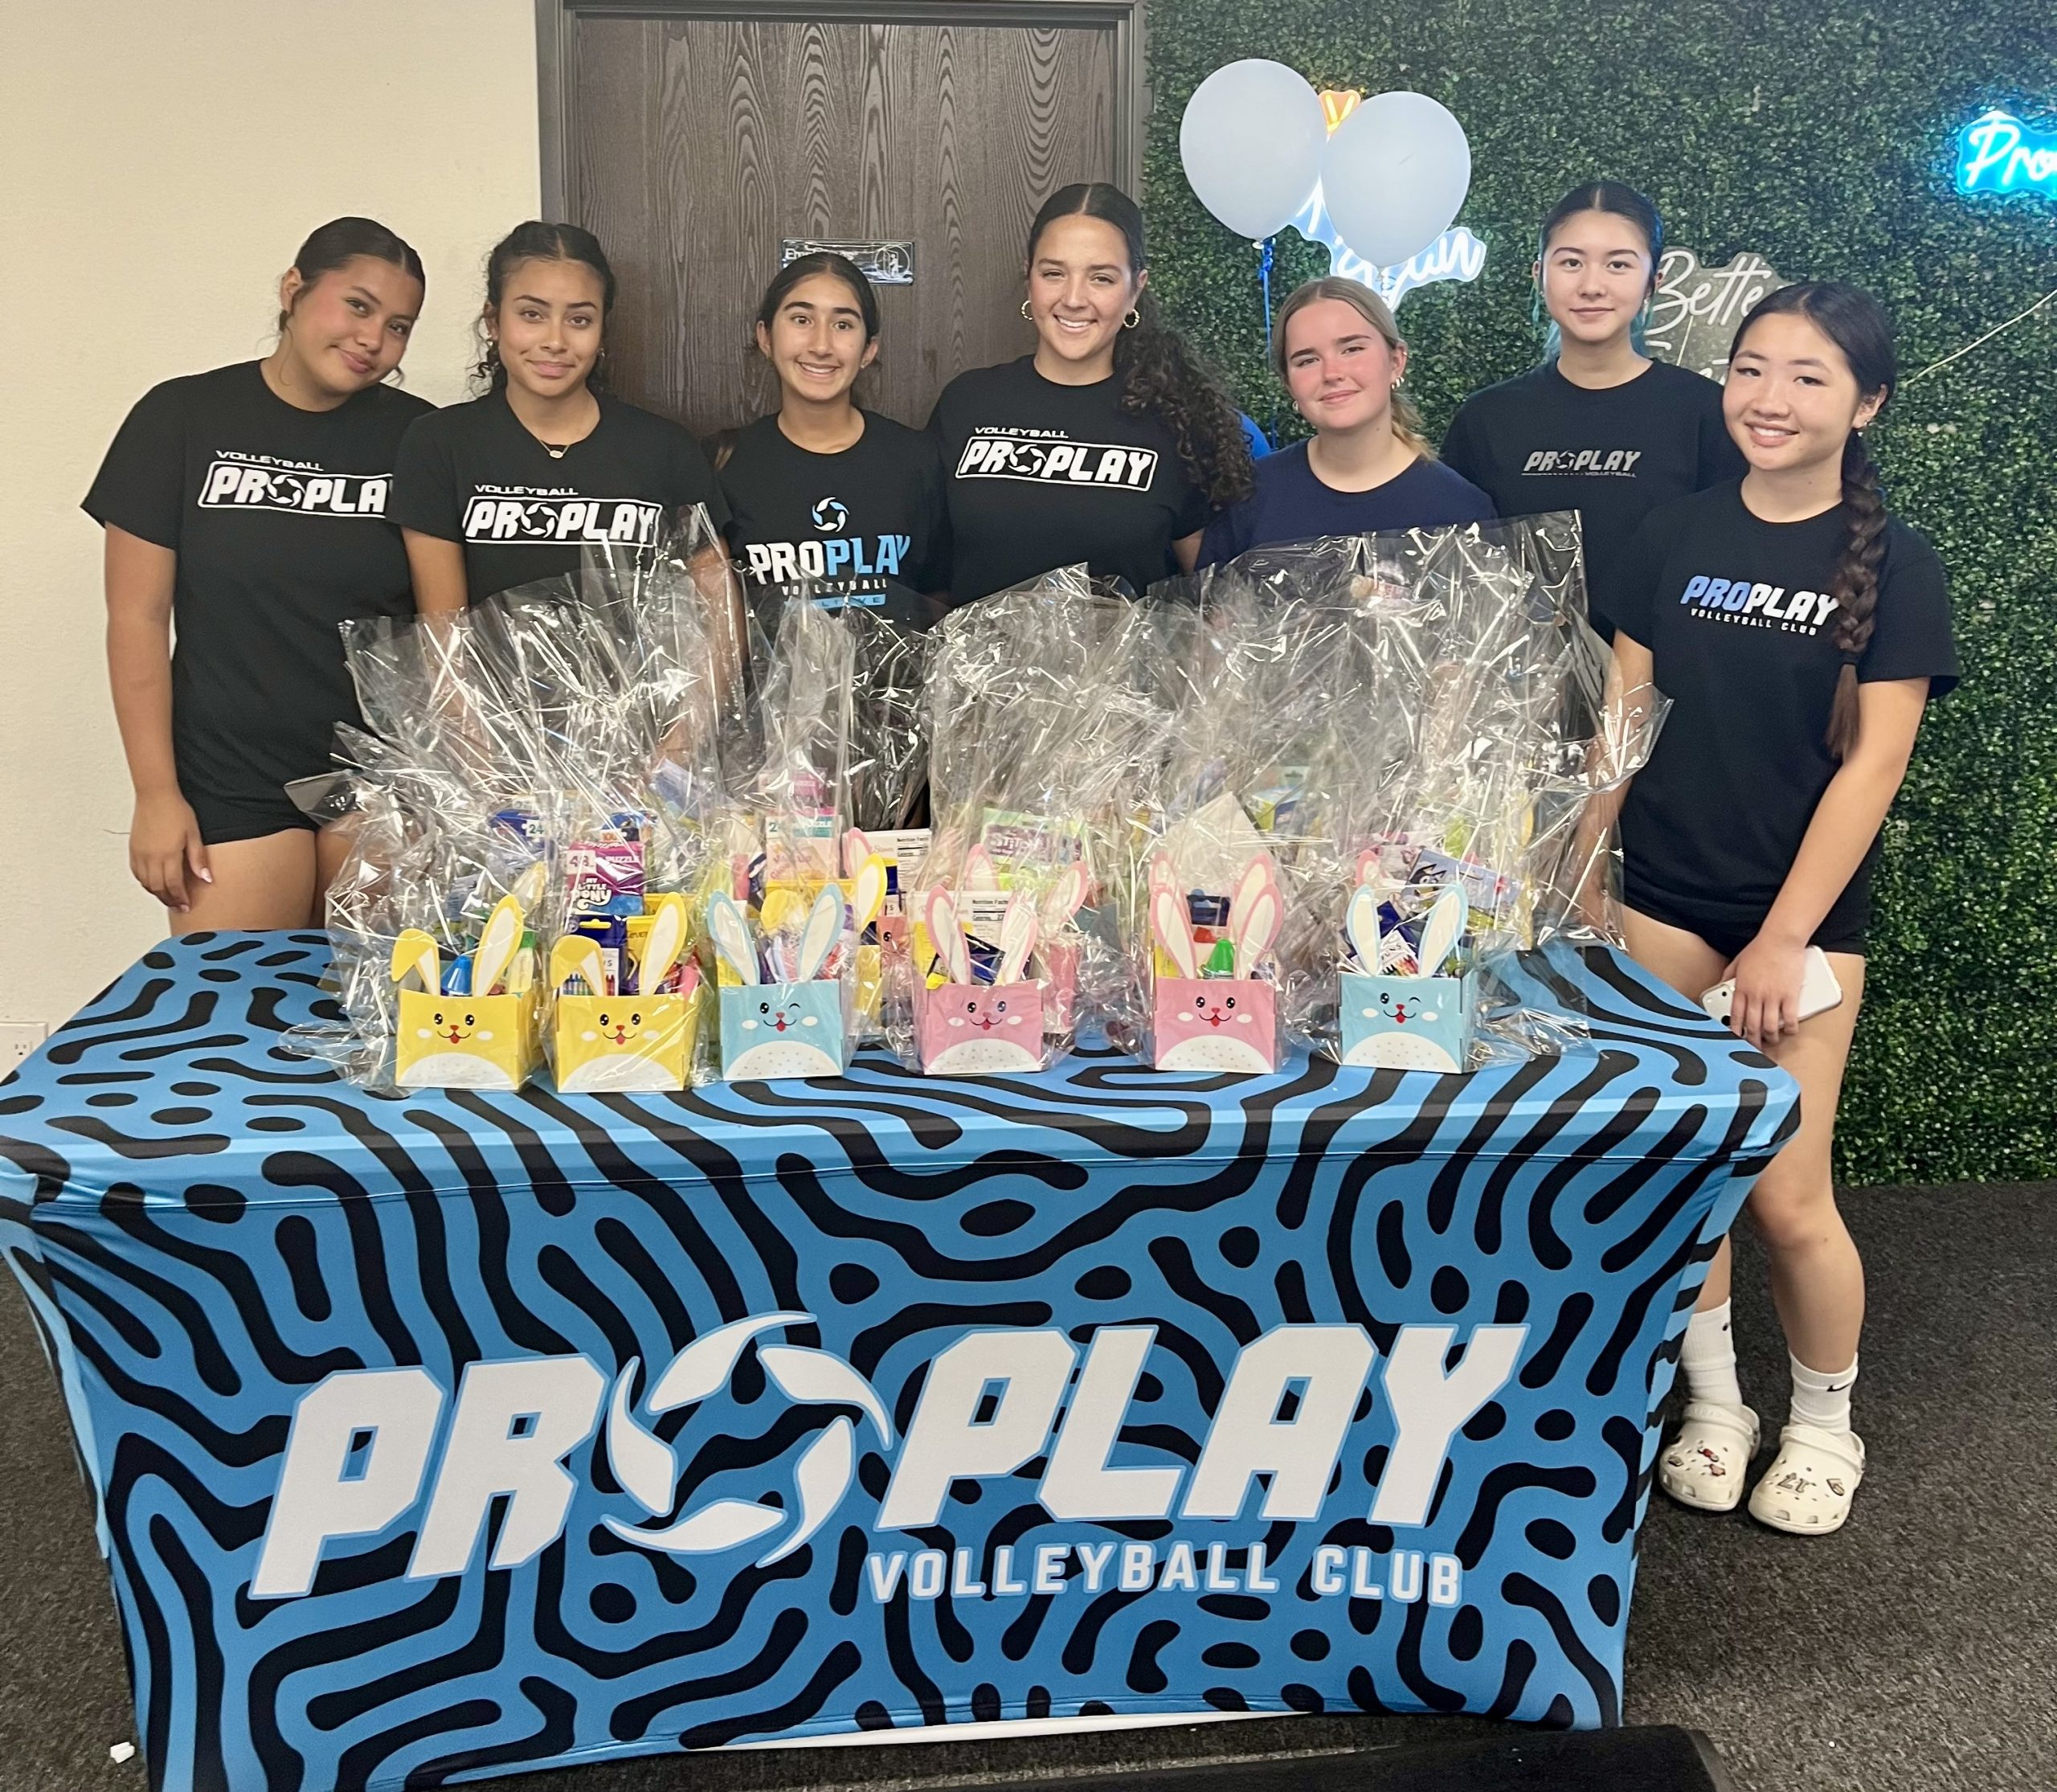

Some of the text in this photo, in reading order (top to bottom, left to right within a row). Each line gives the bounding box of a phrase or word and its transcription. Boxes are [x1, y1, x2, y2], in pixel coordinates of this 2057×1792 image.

[1644, 249, 1785, 336] Bette
[975, 427, 1069, 439] VOLLEYBALL
[215, 450, 325, 472] VOLLEYBALL
[959, 441, 1153, 486] PROPLAY
[206, 466, 393, 513] PROPLA
[474, 485, 579, 496] VOLLEYBALL
[464, 501, 656, 543] PROPLAY
[746, 534, 911, 585] PROPLAY
[781, 578, 887, 596] VOLEYBALL
[1680, 575, 1840, 626] PROPLAY
[1691, 608, 1817, 636] VOLLEYBALL CLUB
[247, 1311, 1532, 1600] PROPLAY
[868, 1542, 1463, 1606] VOLLEYBALL CLUB
